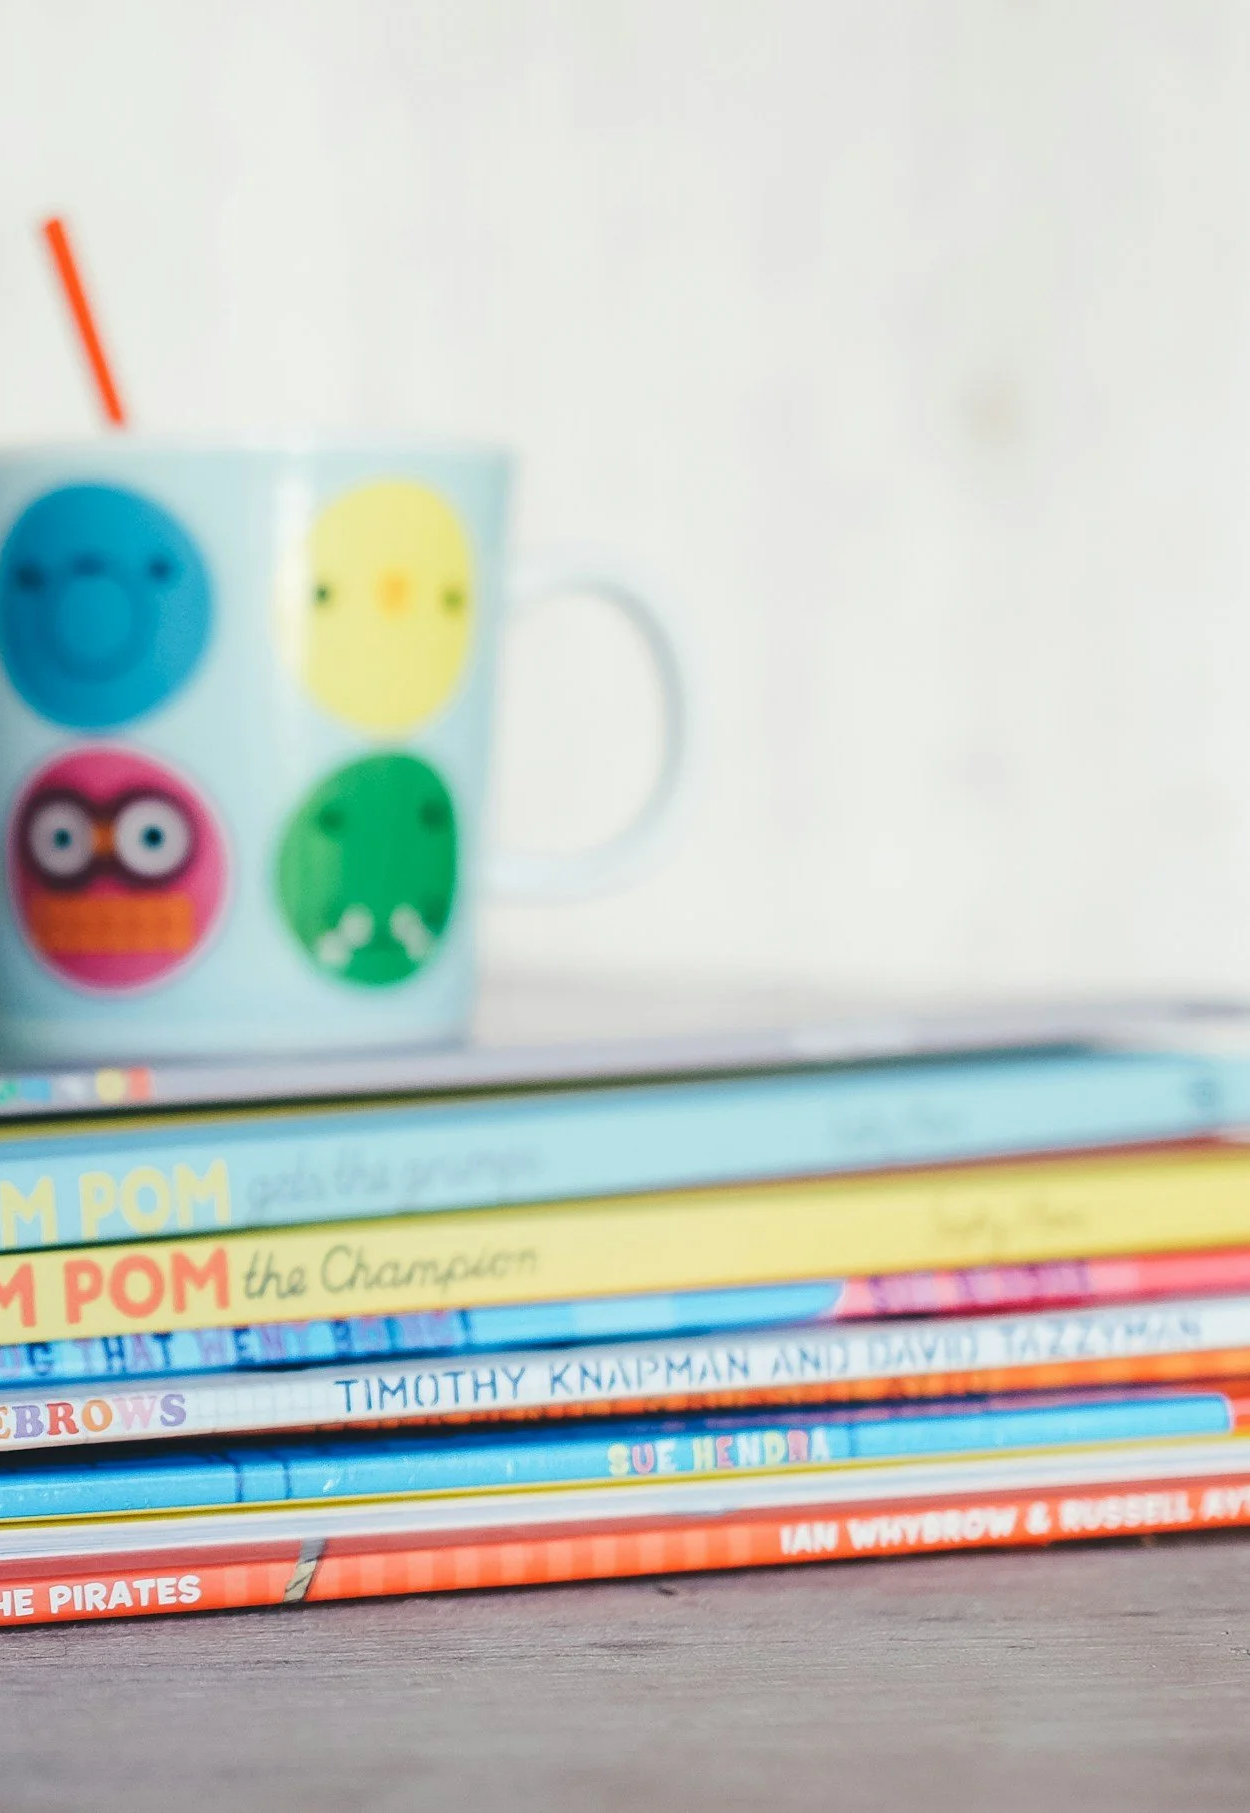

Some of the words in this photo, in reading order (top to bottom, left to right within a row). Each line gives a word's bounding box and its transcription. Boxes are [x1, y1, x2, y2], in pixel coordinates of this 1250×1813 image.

[79, 1159, 231, 1239] POM
[63, 1248, 230, 1324] POM
[243, 1250, 306, 1300] the
[320, 1244, 540, 1305] Champion
[73, 1331, 175, 1374] THAT
[335, 1366, 526, 1413] TIMOTHY
[550, 1346, 751, 1398] KNAPMAN
[771, 1338, 850, 1379] AND
[607, 1440, 677, 1476] SUE
[692, 1428, 831, 1471] HENDRA
[781, 1521, 838, 1555] IAN
[849, 1508, 1018, 1550] WHYBROW
[1026, 1501, 1050, 1535] &
[1059, 1490, 1192, 1533] RUSSELL
[48, 1575, 201, 1614] PIRATES
